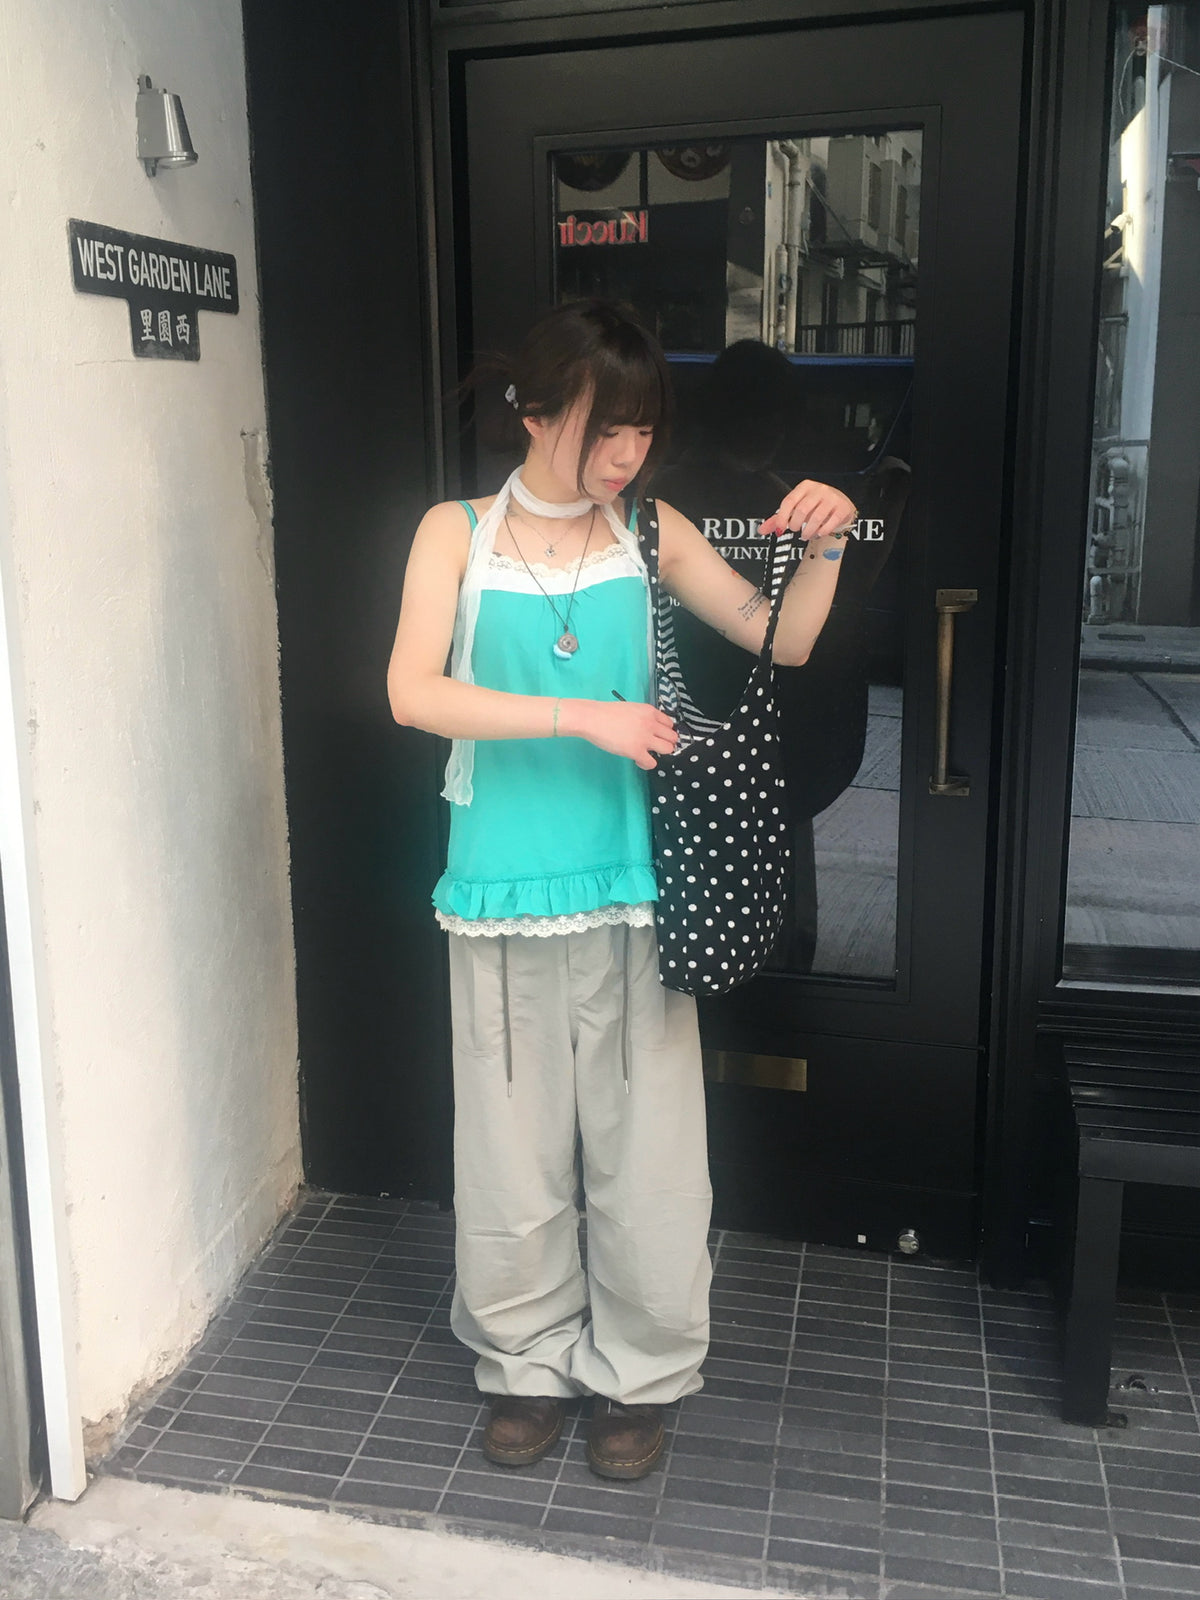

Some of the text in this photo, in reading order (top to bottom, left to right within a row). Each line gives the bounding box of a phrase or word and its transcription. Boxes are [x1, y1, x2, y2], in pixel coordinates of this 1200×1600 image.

[77, 237, 232, 300] WEST GARDEN LANE
[702, 518, 771, 540] RDE
